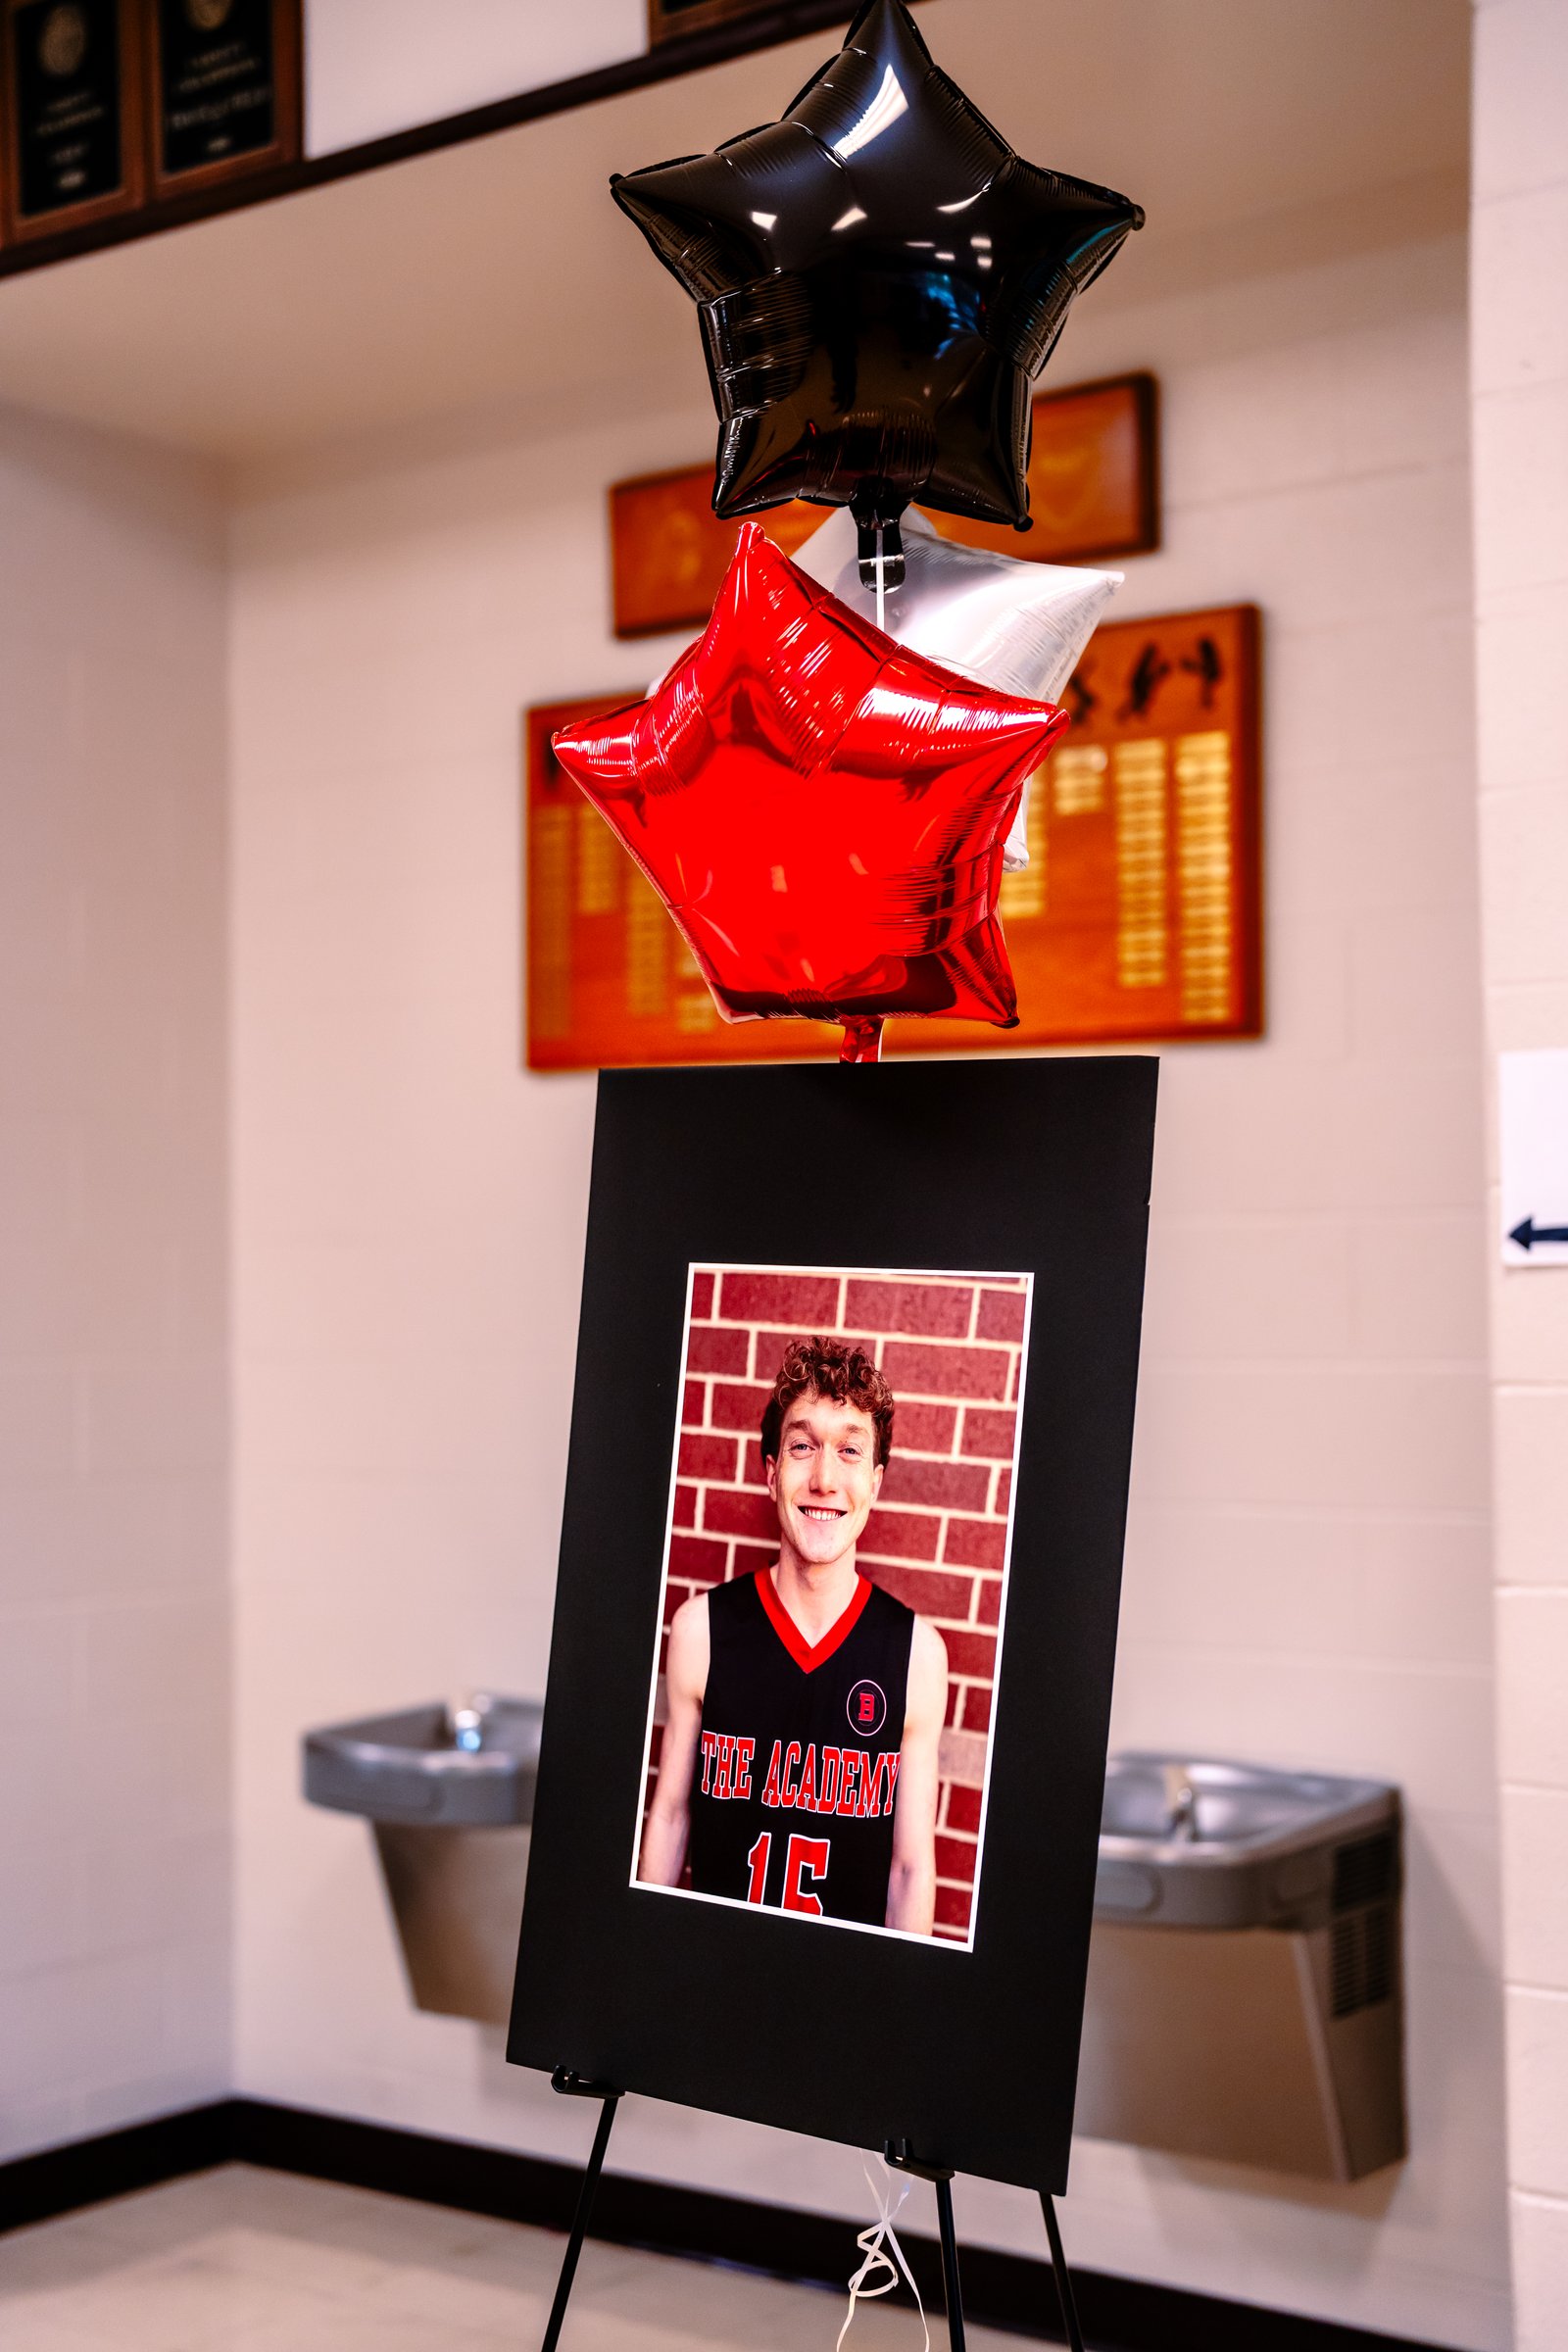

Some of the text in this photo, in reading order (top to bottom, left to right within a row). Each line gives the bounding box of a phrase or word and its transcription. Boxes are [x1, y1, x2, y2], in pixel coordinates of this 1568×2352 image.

[858, 1692, 875, 1722] B
[701, 1730, 901, 1818] THE ACADEMY
[747, 1832, 831, 1916] 15
